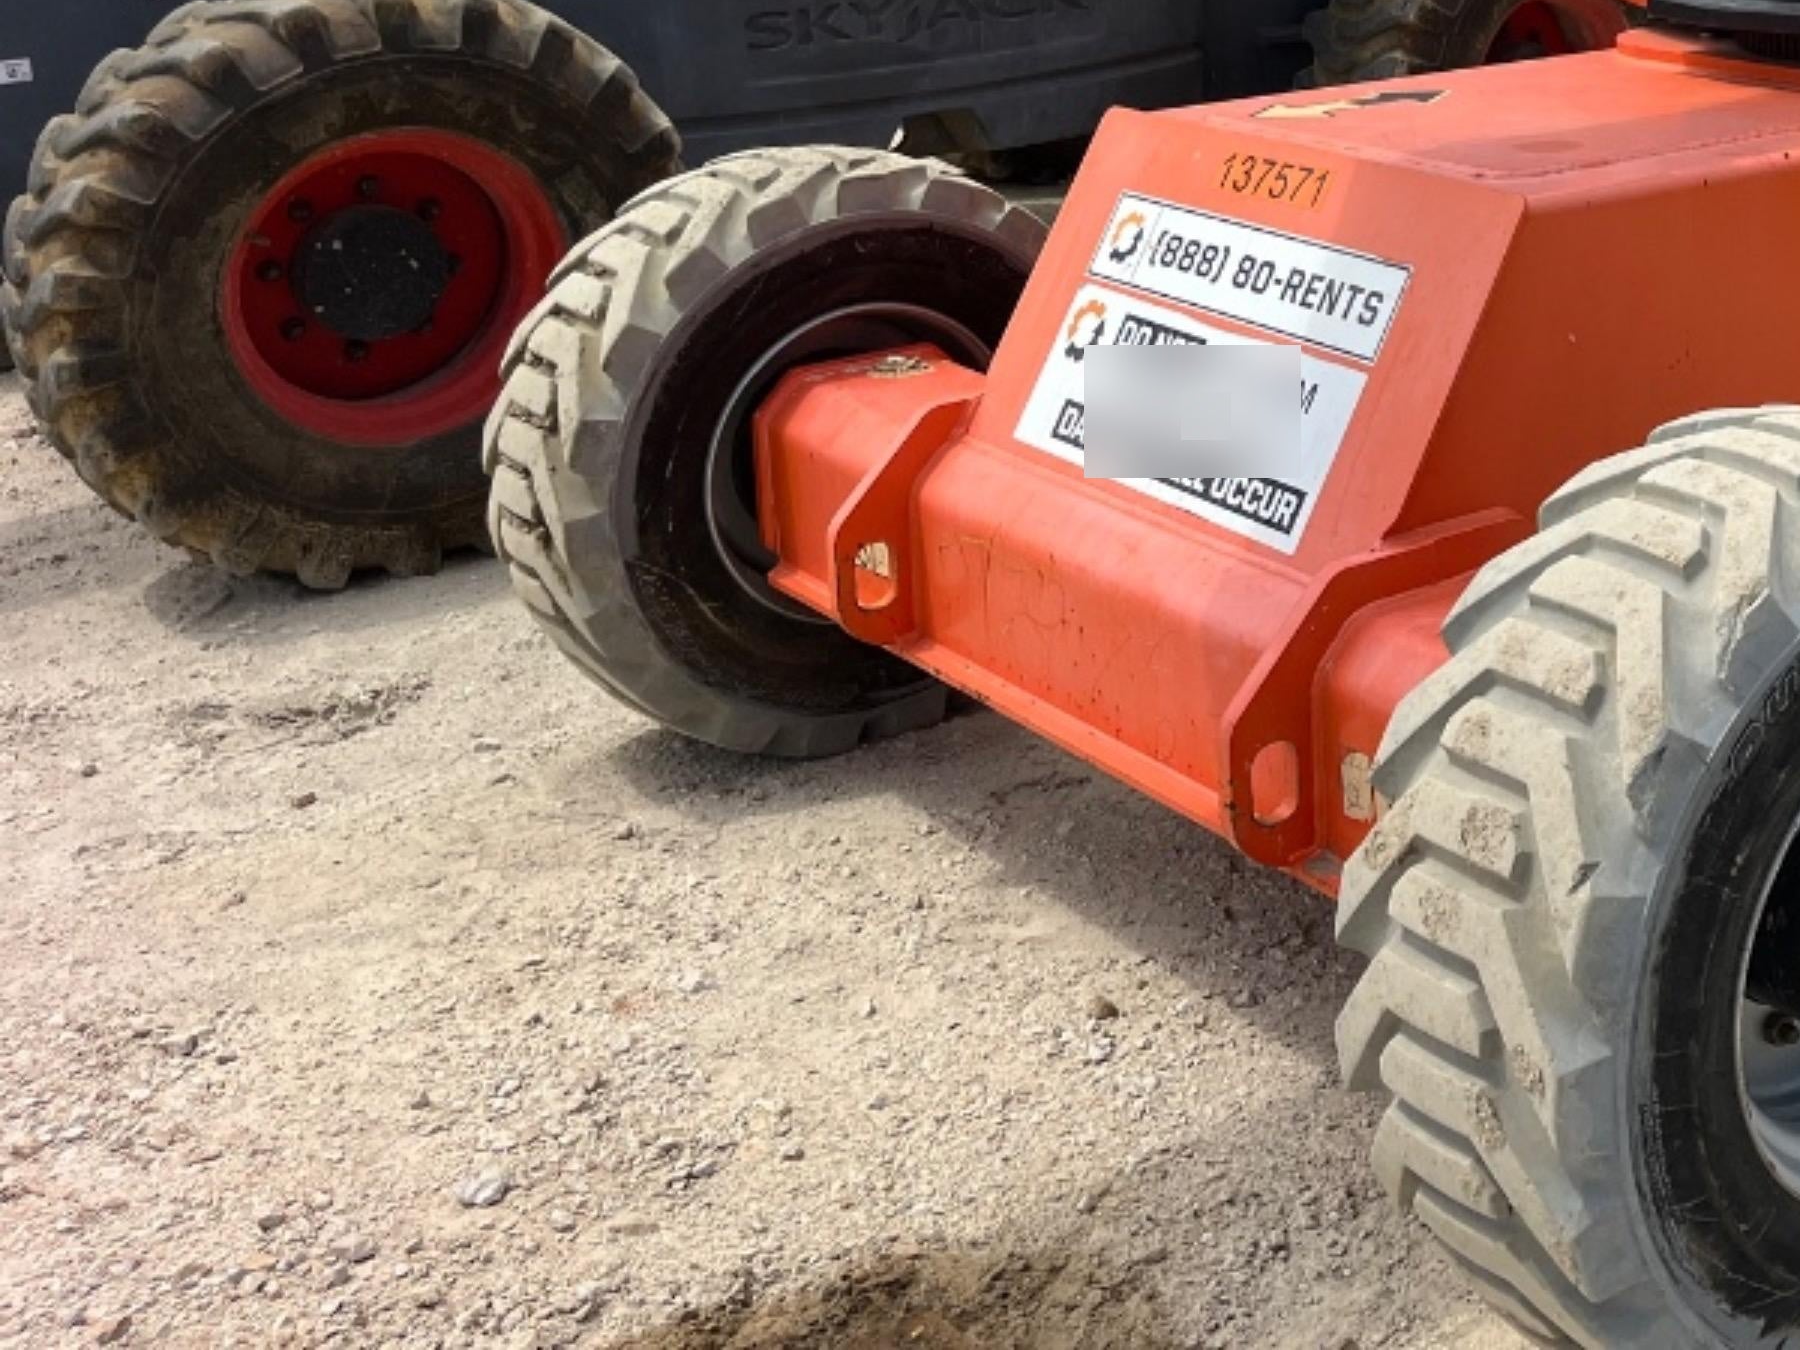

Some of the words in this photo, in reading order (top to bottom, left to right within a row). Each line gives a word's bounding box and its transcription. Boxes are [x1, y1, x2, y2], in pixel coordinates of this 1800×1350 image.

[1221, 152, 1330, 208] 137571
[1149, 229, 1232, 286] (888)
[1232, 253, 1385, 329] 80-RENTS
[1209, 478, 1299, 529] OCCUR
